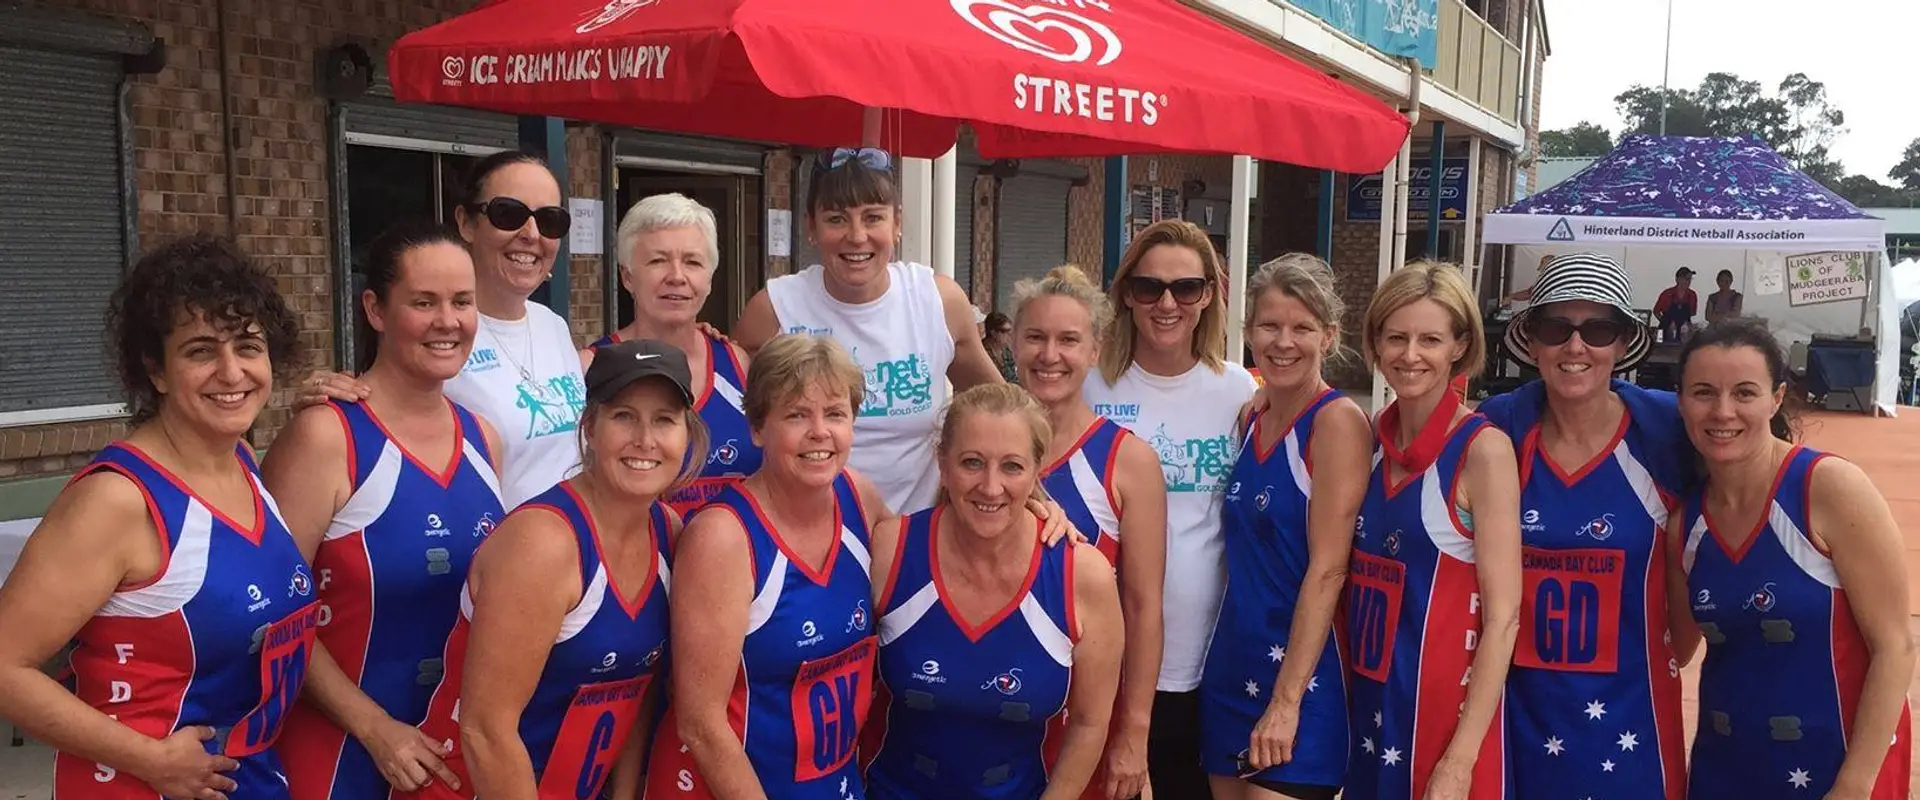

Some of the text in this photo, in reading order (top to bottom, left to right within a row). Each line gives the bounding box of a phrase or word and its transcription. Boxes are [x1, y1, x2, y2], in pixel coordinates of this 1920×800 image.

[470, 55, 499, 84] ICE
[504, 52, 554, 84] CREAM
[1583, 224, 1806, 241] Hinterland District Netball Association
[1789, 251, 1862, 268] LIONS CLUB
[1818, 266, 1834, 276] OF
[1790, 274, 1865, 290] MUDGEERABA
[1802, 287, 1854, 301] PROJECT
[876, 353, 922, 383] net
[884, 373, 932, 408] fest
[1186, 434, 1230, 459] net
[1522, 554, 1615, 574] CANADA BAY CLUB
[1535, 576, 1599, 665] GD
[808, 671, 859, 771] GK
[575, 709, 616, 800] C
